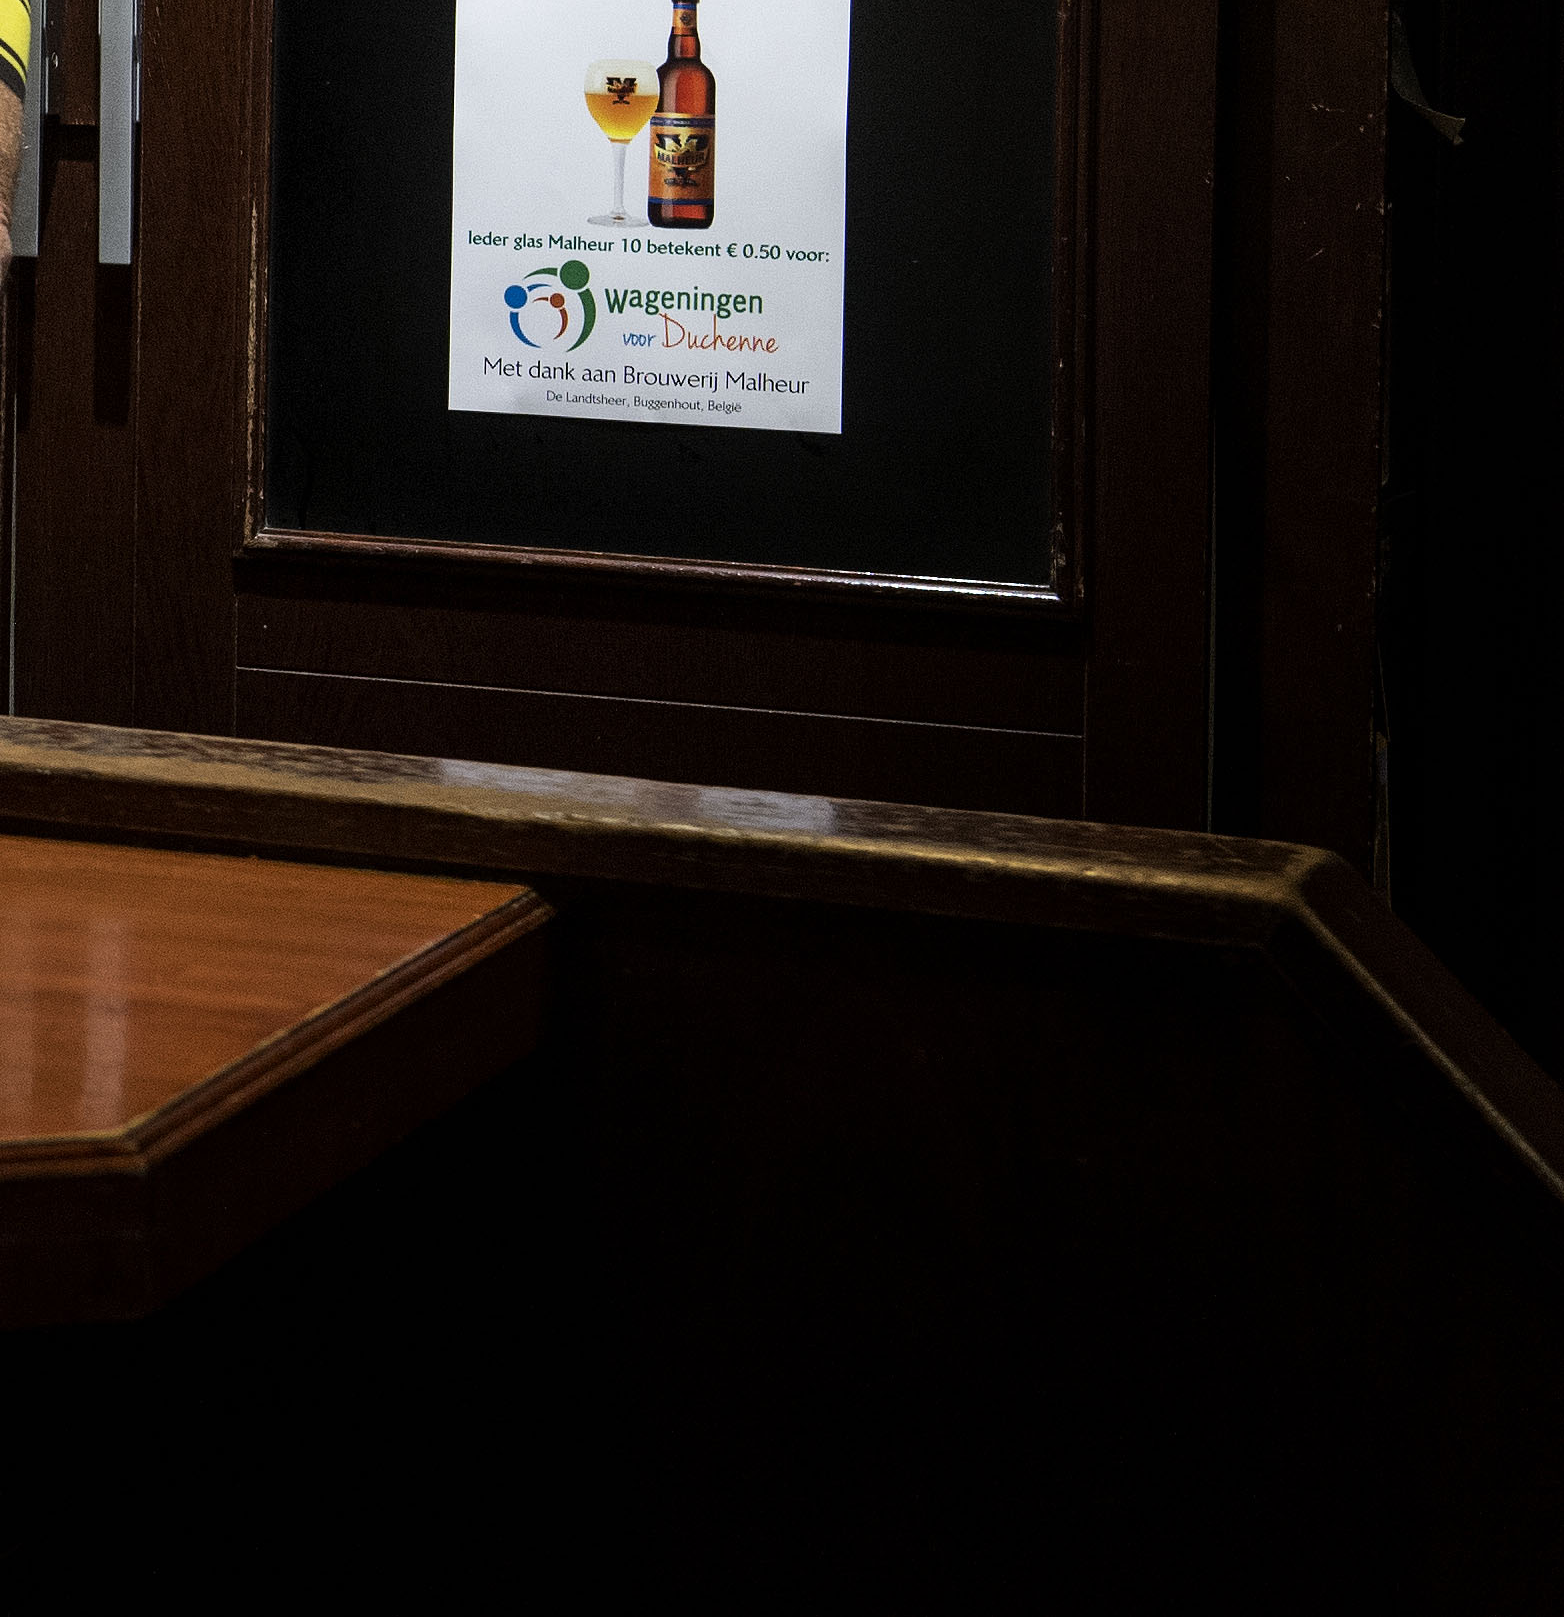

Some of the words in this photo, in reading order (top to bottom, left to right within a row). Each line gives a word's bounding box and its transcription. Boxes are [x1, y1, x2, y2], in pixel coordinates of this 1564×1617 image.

[468, 230, 509, 248] Ieder
[513, 233, 543, 251] glas
[548, 234, 615, 252] Malheur
[622, 238, 641, 253] 10
[647, 238, 721, 257] betekent
[726, 243, 738, 258] €
[743, 243, 781, 261] 0.50
[786, 247, 831, 263] voor:
[623, 332, 657, 348] voor
[659, 313, 780, 355] Duchenne
[483, 356, 523, 379] Met
[528, 359, 575, 381] dank
[581, 368, 617, 384] aan
[623, 366, 719, 393] Brouwerij
[725, 372, 810, 395] Malheur
[546, 390, 564, 403] De
[566, 391, 631, 408] Landtsheer,
[633, 396, 705, 412] Buggenhout,
[708, 399, 743, 415] België
